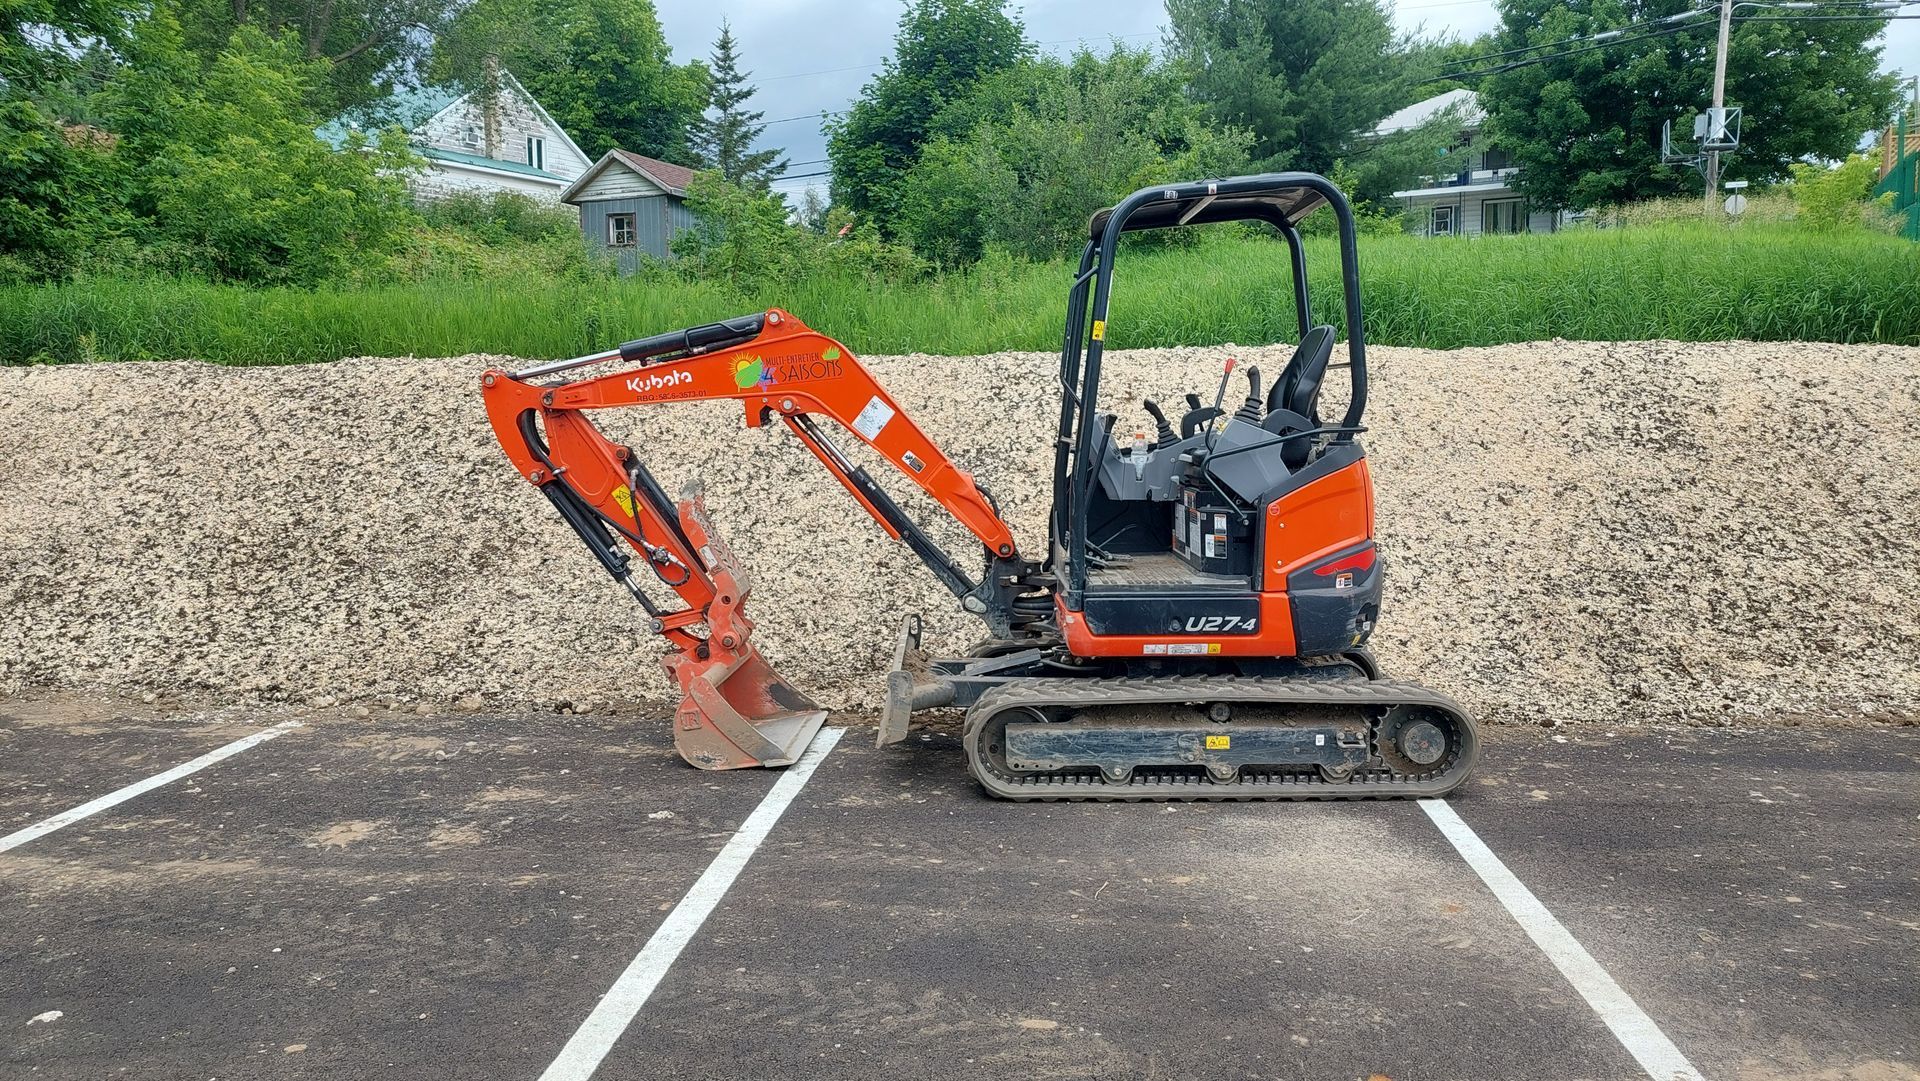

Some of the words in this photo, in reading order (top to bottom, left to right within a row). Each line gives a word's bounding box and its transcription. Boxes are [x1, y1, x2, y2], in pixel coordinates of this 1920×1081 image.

[766, 352, 820, 367] MULTI-ENTRETIEN
[626, 369, 693, 392] Kubota
[764, 367, 774, 383] 4
[780, 360, 843, 382] SAISONS
[1185, 616, 1257, 632] U27-4
